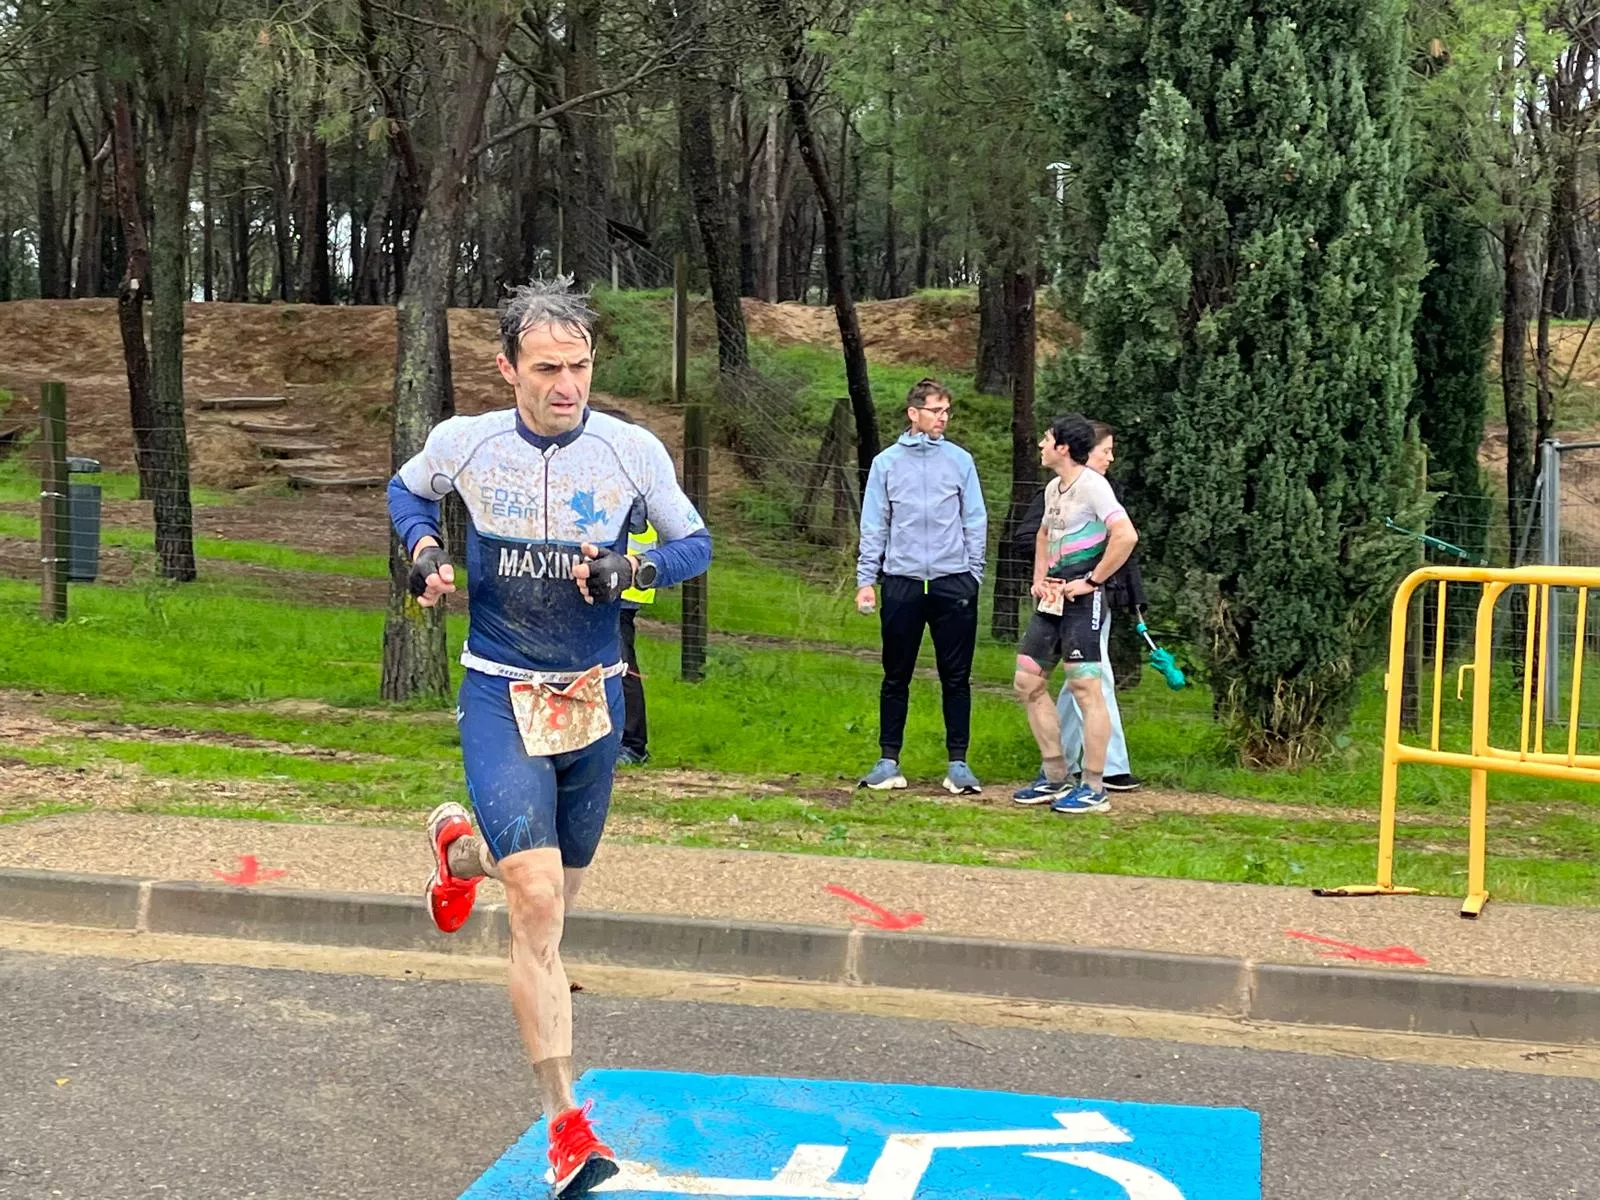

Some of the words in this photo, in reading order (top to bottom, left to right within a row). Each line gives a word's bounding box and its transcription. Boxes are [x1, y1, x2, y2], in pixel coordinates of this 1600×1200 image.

[481, 486, 540, 506] COIX
[480, 500, 539, 520] TEAM
[498, 543, 592, 580] MÁXIM
